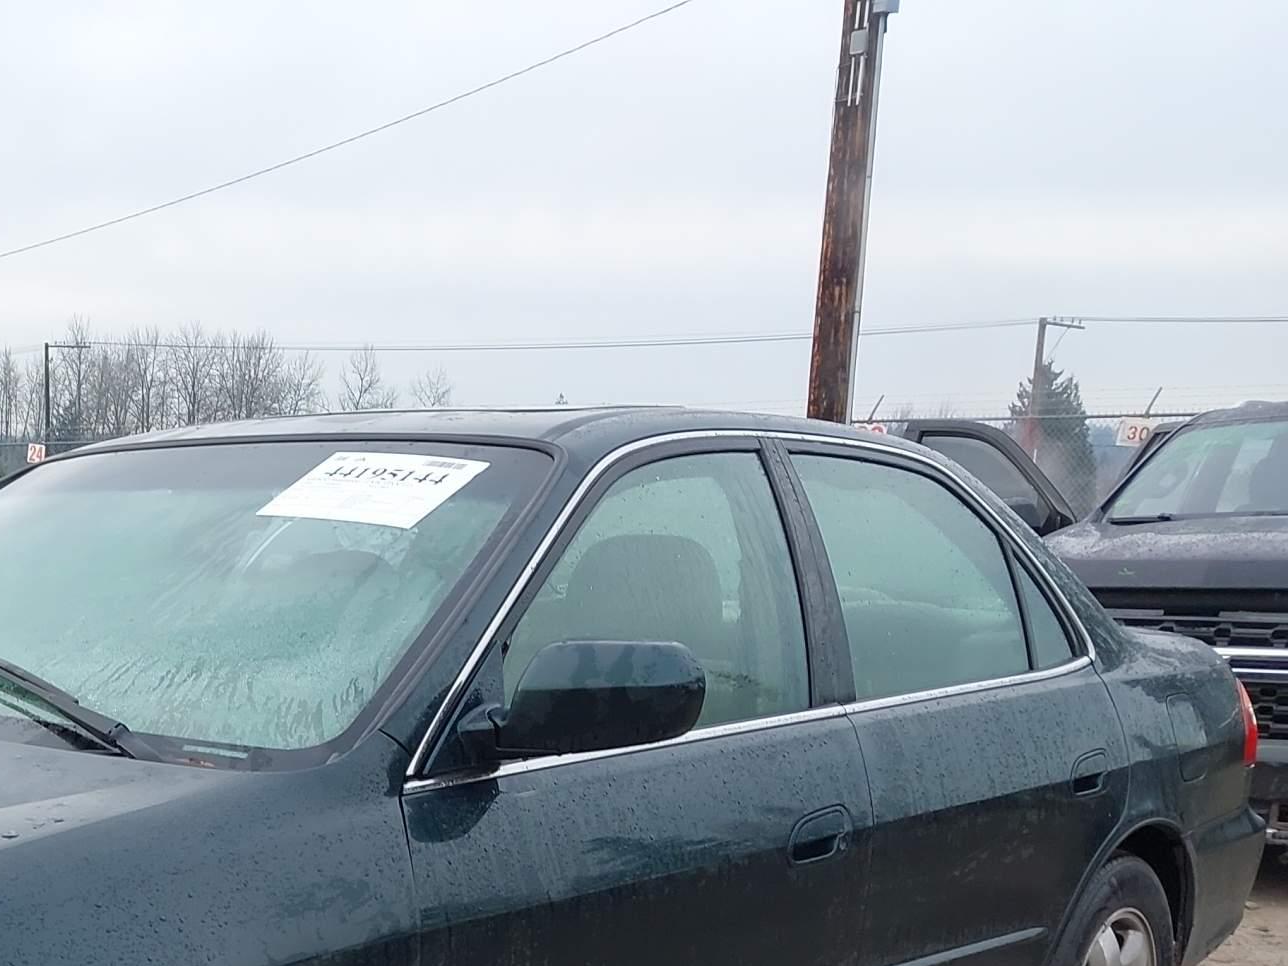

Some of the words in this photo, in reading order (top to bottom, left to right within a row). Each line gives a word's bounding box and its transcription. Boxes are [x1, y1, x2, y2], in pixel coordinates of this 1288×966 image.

[1127, 426, 1150, 441] 30
[29, 445, 43, 461] 24
[324, 466, 450, 485] 44195144
